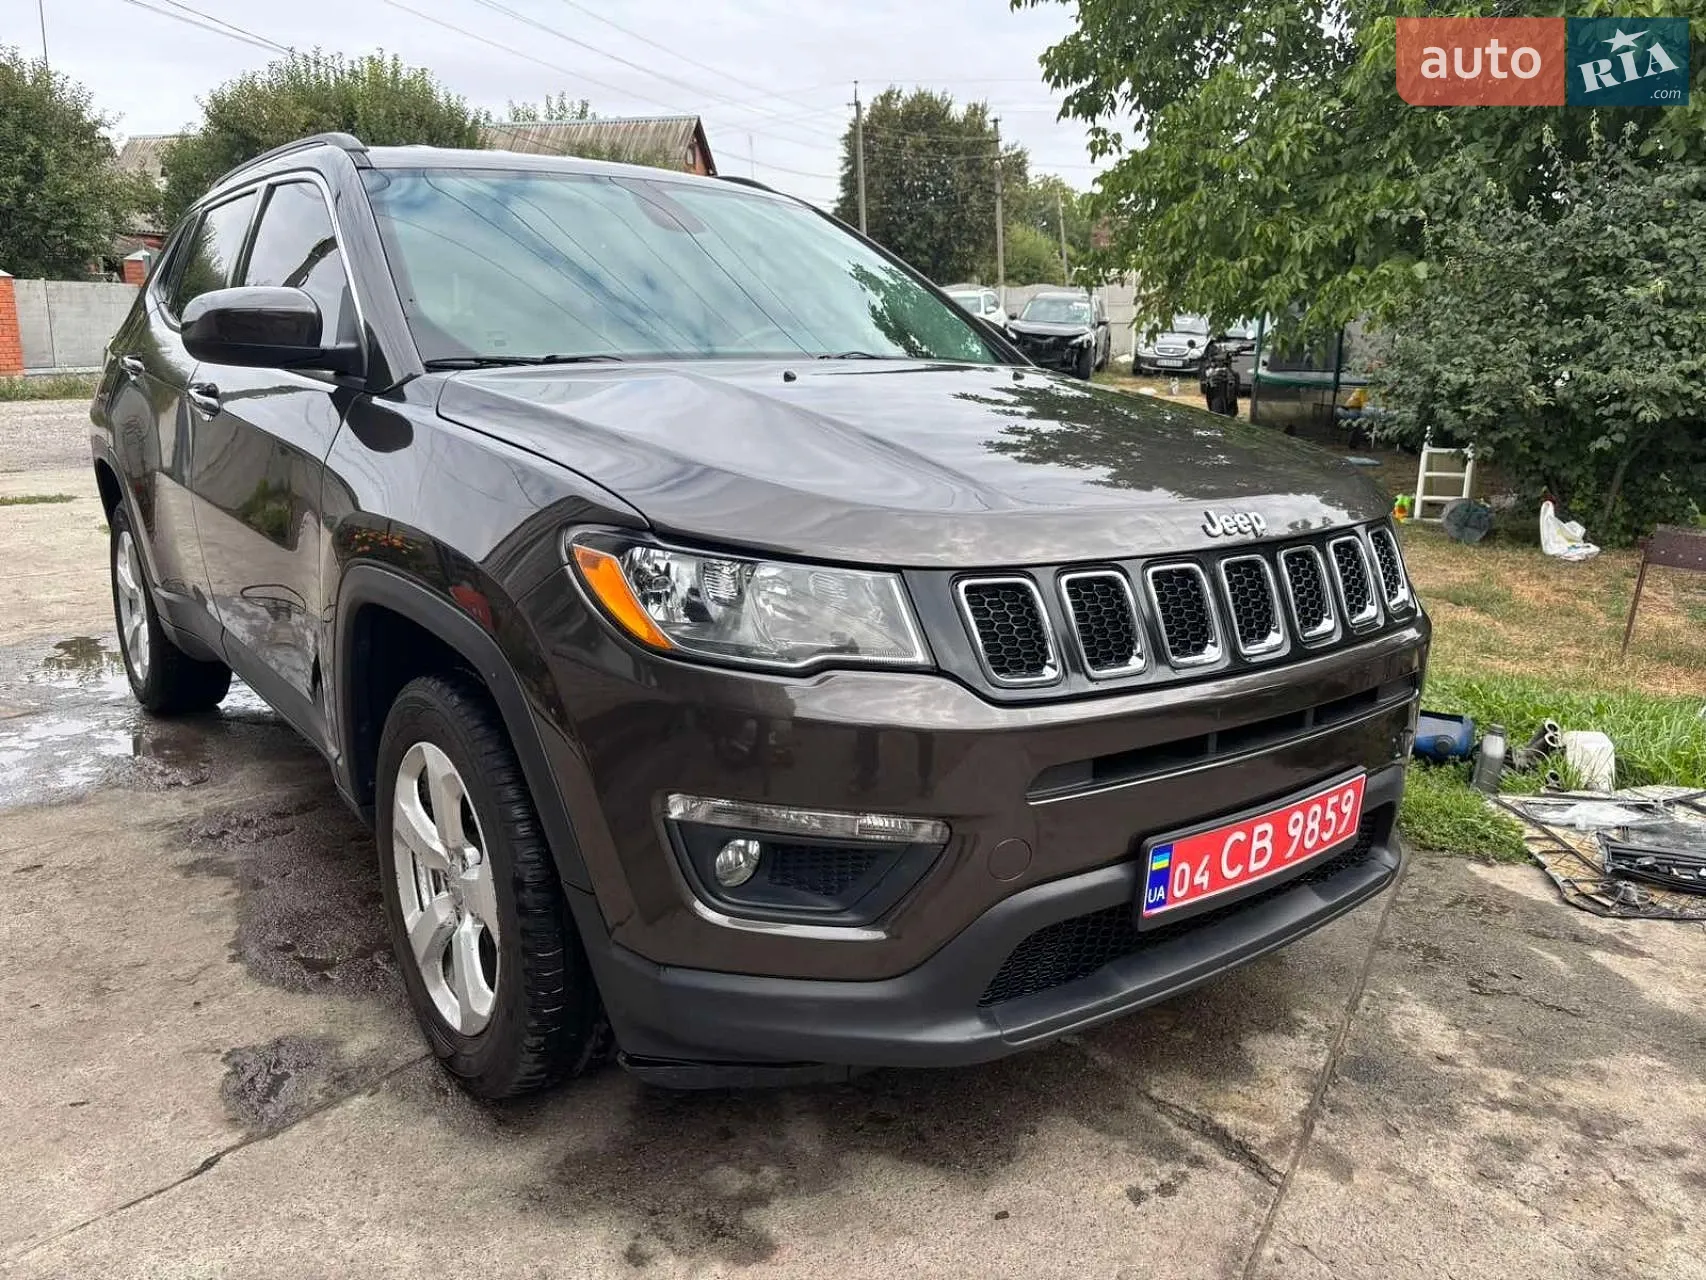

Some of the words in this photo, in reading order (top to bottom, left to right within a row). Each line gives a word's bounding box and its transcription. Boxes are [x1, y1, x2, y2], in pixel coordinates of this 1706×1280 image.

[1202, 510, 1266, 538] Jeep
[1173, 856, 1209, 898] 04
[1221, 822, 1274, 880] CB
[1285, 788, 1355, 859] 9859
[1148, 886, 1165, 904] UA
